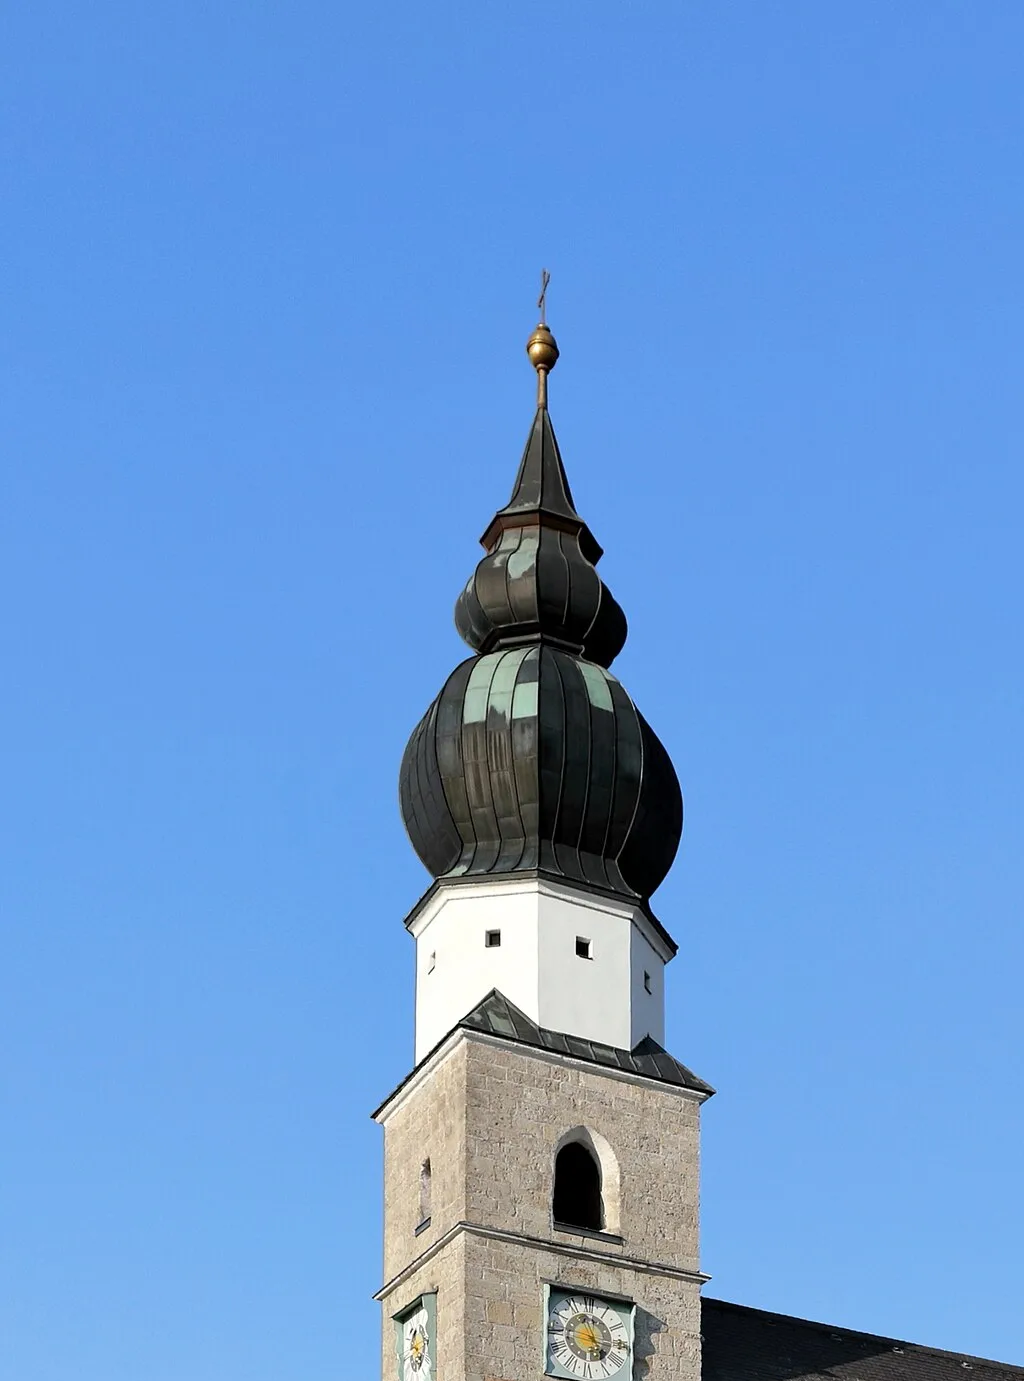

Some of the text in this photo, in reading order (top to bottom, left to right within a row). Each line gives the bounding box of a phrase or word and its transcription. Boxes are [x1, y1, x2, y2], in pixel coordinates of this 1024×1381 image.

[566, 1297, 579, 1315] XI
[584, 1296, 595, 1314] XII
[601, 1306, 609, 1319] I
[609, 1322, 624, 1332] II
[551, 1342, 568, 1358] VIII
[564, 1354, 578, 1373] VII
[607, 1351, 625, 1368] IIII
[583, 1362, 593, 1378] VI
[601, 1363, 610, 1378] V
